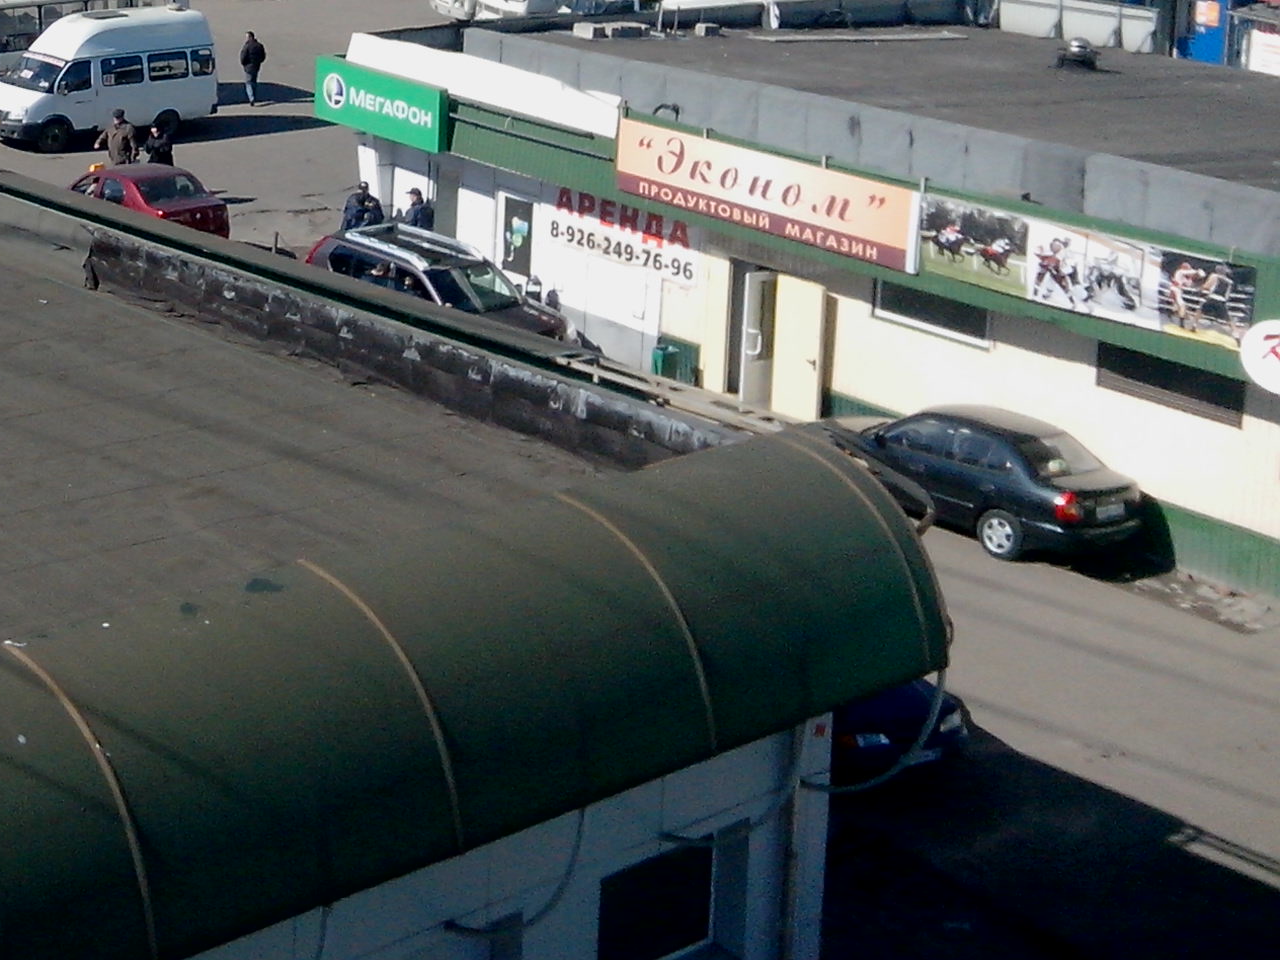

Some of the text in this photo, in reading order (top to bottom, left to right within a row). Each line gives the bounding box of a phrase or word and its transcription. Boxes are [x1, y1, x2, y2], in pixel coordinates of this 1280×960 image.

[555, 186, 690, 249] АРЕНДА
[638, 180, 879, 260] ПРОДУКТОВЫЙ МАГАЗИН
[550, 220, 693, 281] 8-926-249-76-96
